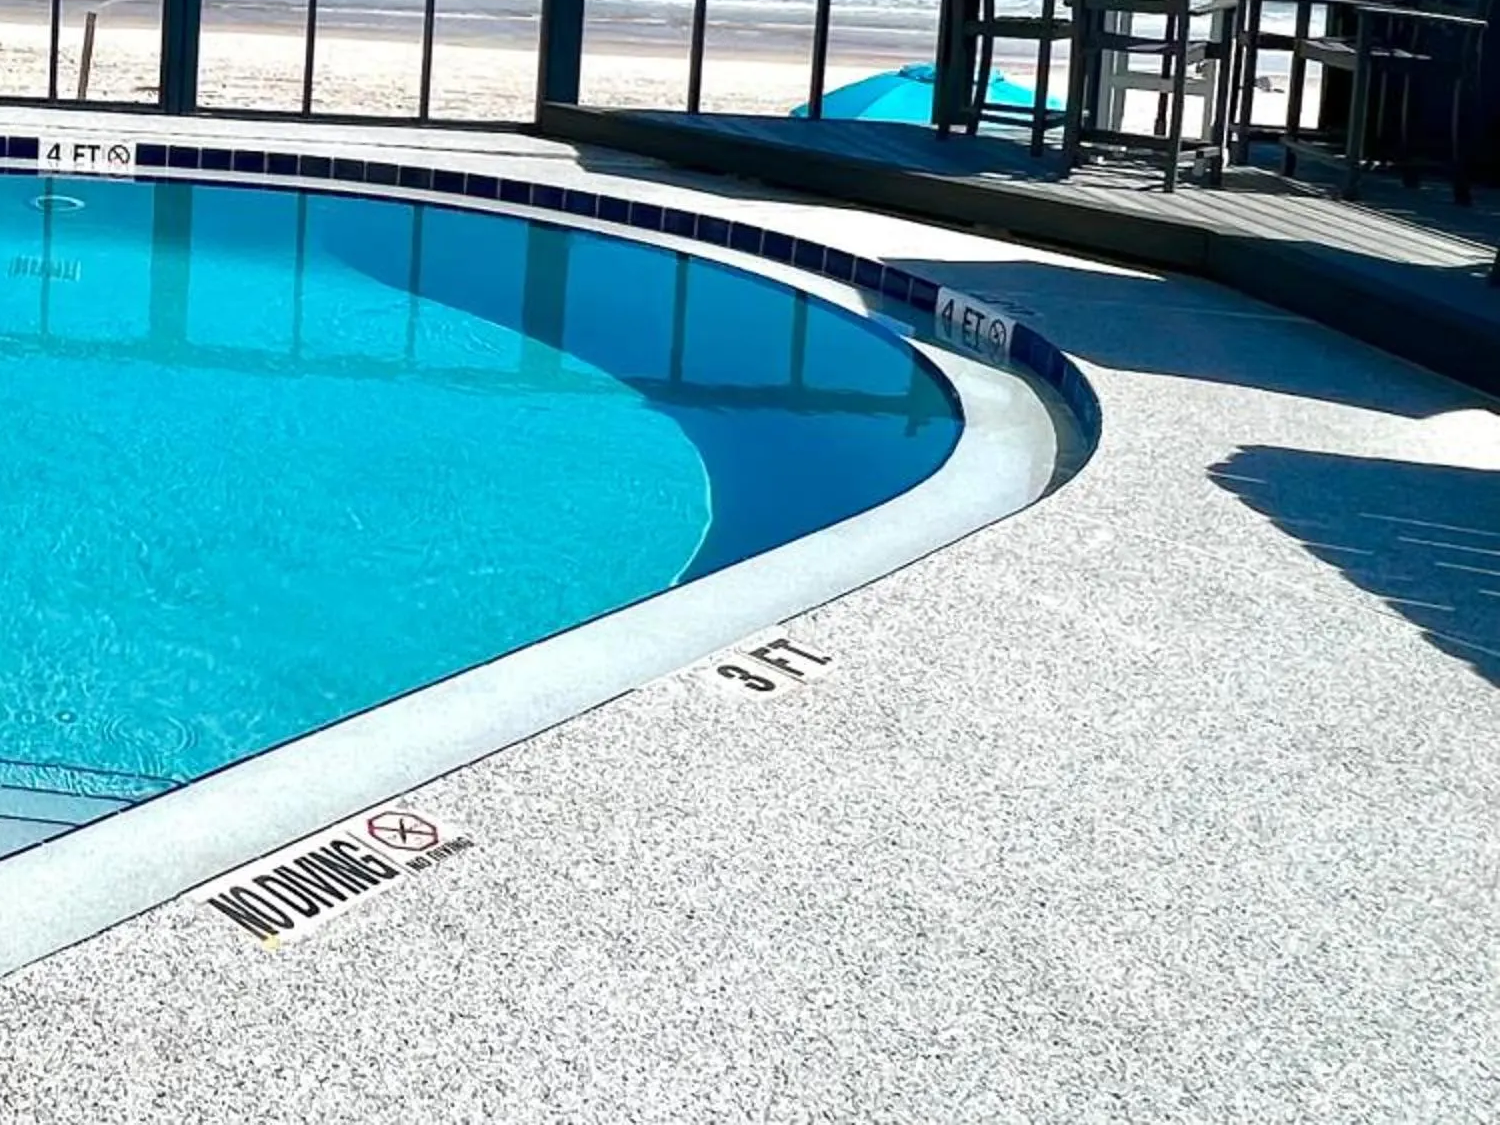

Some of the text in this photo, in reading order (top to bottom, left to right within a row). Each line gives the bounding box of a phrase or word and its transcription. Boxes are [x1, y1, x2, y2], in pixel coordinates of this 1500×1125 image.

[46, 143, 101, 163] 4 FT
[942, 298, 955, 322] 4
[963, 306, 985, 337] FT
[717, 638, 828, 692] 3 FT
[405, 855, 432, 872] NO
[207, 839, 400, 941] NO DIVING
